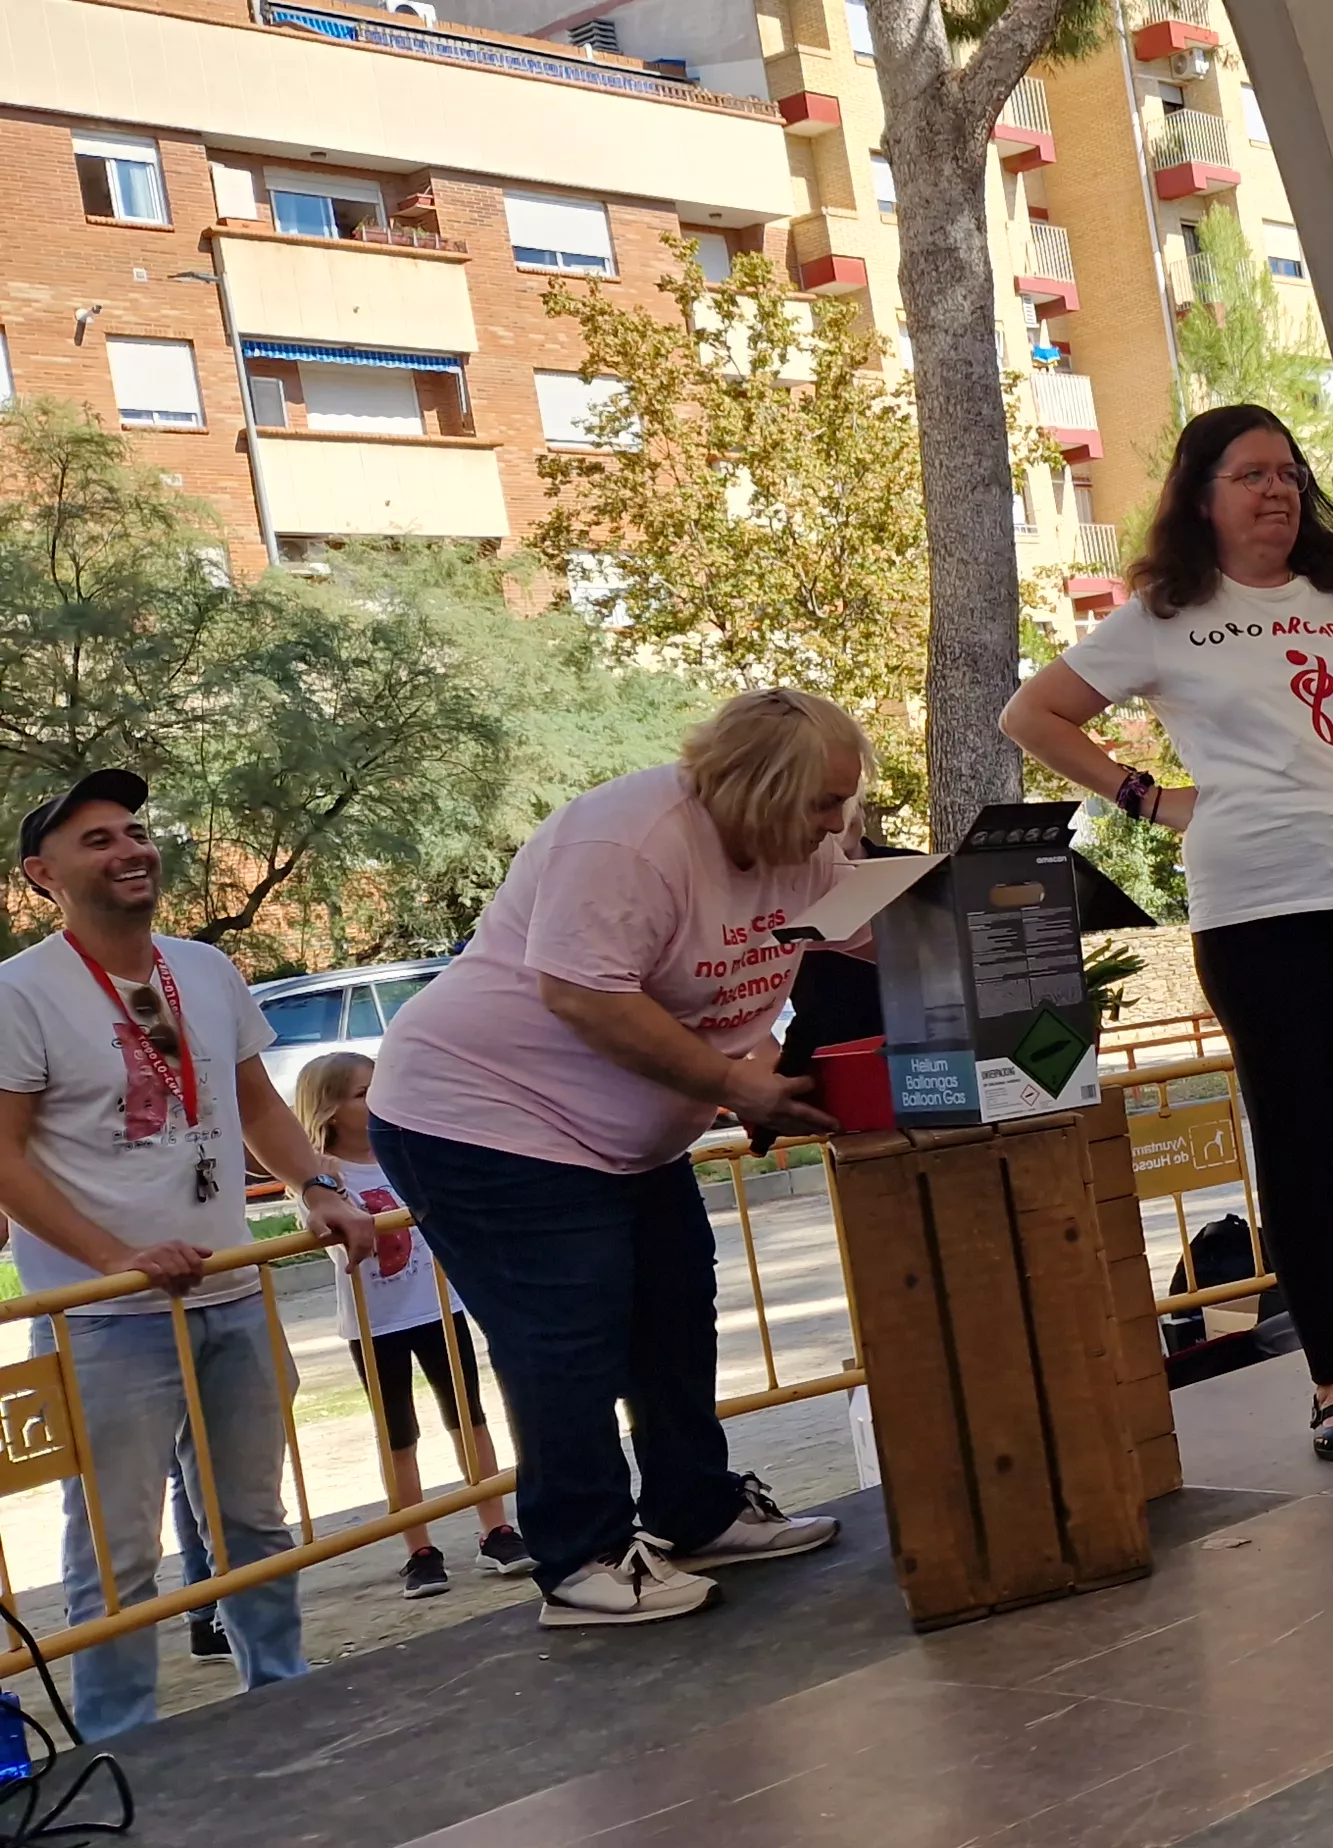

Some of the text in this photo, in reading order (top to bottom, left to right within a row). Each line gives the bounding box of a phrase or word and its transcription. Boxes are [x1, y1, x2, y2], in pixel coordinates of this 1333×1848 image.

[1189, 622, 1263, 646] CORO
[722, 923, 748, 946] Las
[695, 960, 727, 978] no
[138, 1034, 156, 1062] TODO
[911, 1058, 948, 1073] Helium
[906, 1075, 958, 1091] Ballongas
[902, 1091, 942, 1107] Balloon
[943, 1090, 966, 1106] Gas
